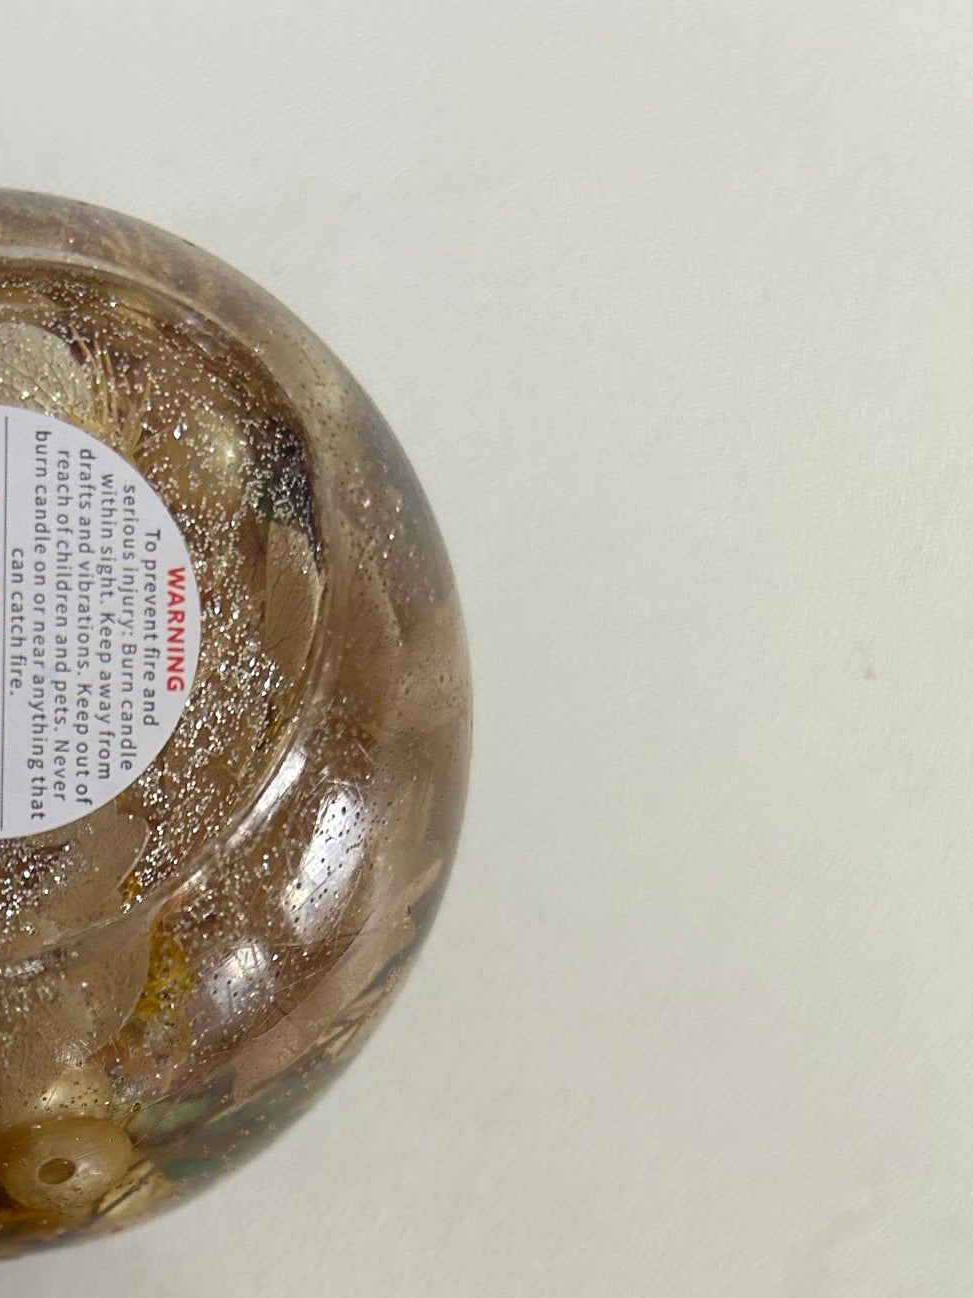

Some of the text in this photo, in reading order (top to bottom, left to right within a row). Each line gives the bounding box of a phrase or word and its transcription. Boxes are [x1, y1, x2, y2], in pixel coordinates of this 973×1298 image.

[9, 547, 28, 696] can catch fire.
[26, 430, 53, 821] burn candle on or near anything that
[50, 450, 74, 802] reach of children and pets. Never
[72, 448, 97, 806] drafts and vibrations. Keep out of
[94, 473, 119, 780] within sight. Keep away from
[116, 484, 140, 771] serious injury: Burn candle
[140, 528, 162, 727] To prevent fire and
[166, 566, 187, 692] WARNING
